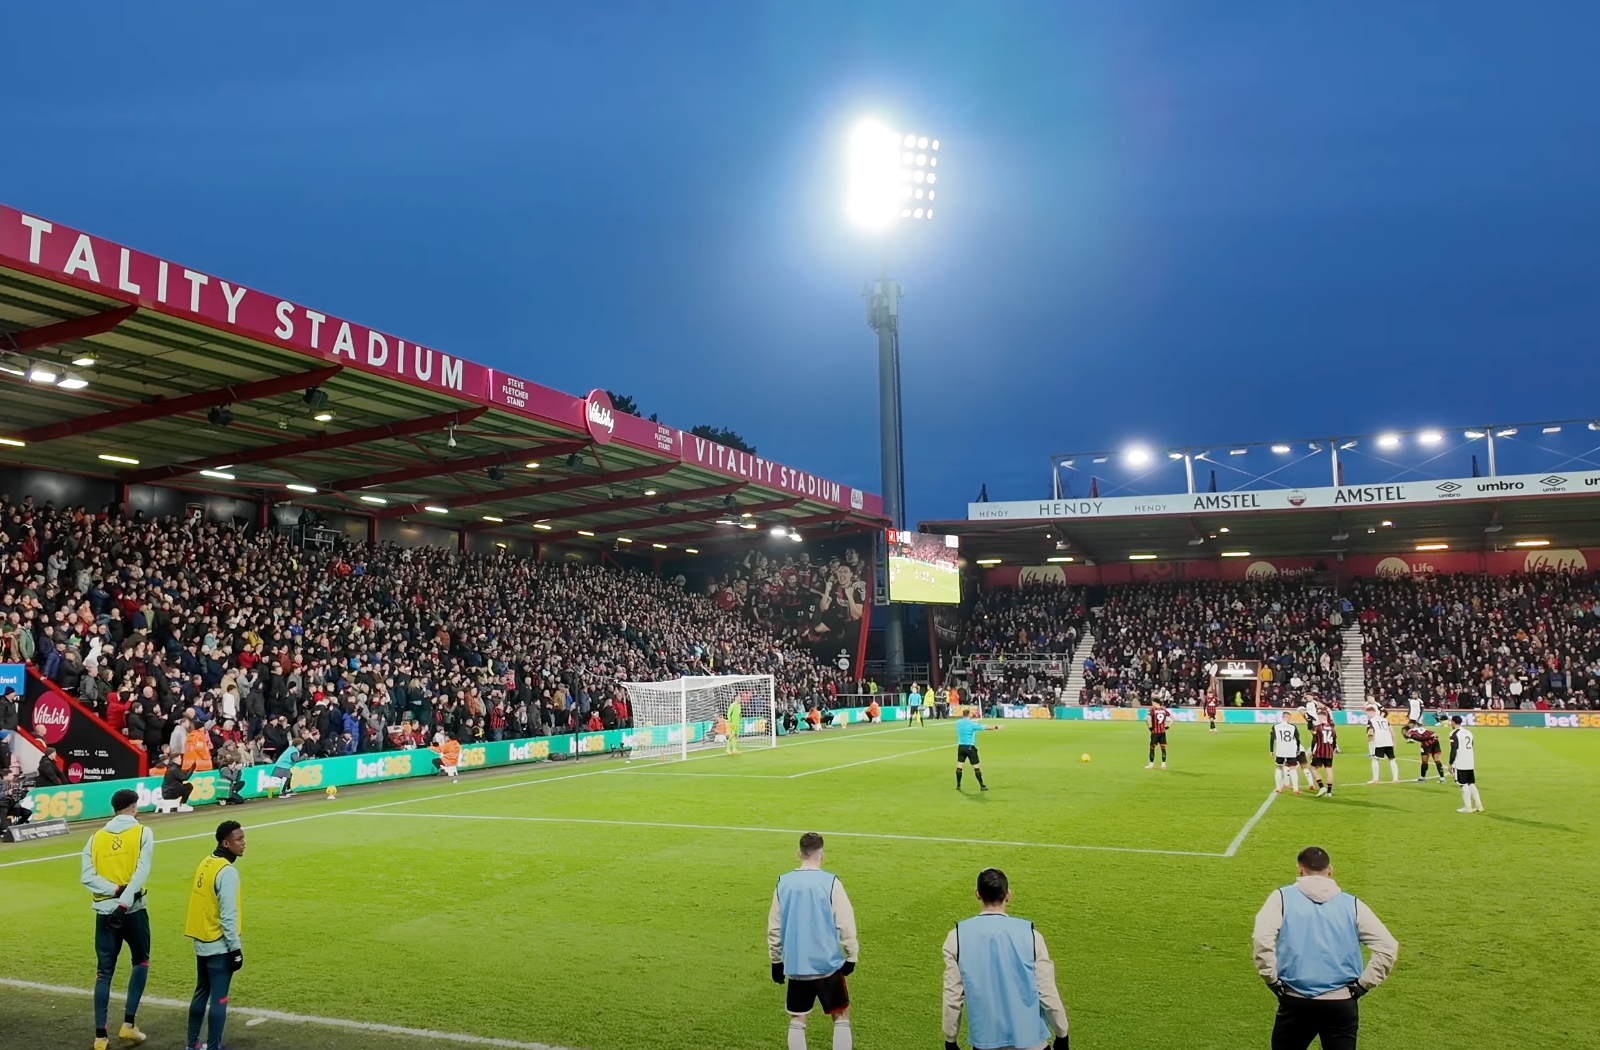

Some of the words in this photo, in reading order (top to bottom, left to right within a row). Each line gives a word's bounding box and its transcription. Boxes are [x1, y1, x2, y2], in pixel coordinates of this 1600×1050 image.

[22, 214, 247, 324] TALITY
[274, 301, 463, 391] STADIUM
[507, 378, 525, 389] STEVE
[502, 386, 529, 400] FLETCHER
[506, 396, 525, 408] STAND
[589, 401, 615, 433] Vitality
[657, 427, 670, 435] STEVE
[654, 433, 673, 444] FLETCHER
[657, 441, 671, 451] STAND
[695, 437, 774, 483] VITALITY
[780, 466, 840, 503] STADIUM
[1476, 481, 1524, 492] umbro
[1334, 486, 1406, 503] AMSTEL
[1134, 504, 1167, 512] HENDY
[1193, 494, 1260, 510] AMSTEL
[980, 510, 1009, 518] HENDY
[1040, 502, 1103, 516] HENDY
[1412, 562, 1434, 573] Life
[1227, 661, 1246, 670] EV1
[34, 703, 70, 731] Vitality
[1156, 713, 1165, 725] 9
[1279, 730, 1292, 742] 18
[1321, 730, 1334, 745] 14
[1465, 736, 1472, 750] 2
[509, 740, 550, 761] bet365
[356, 754, 411, 780] bet365
